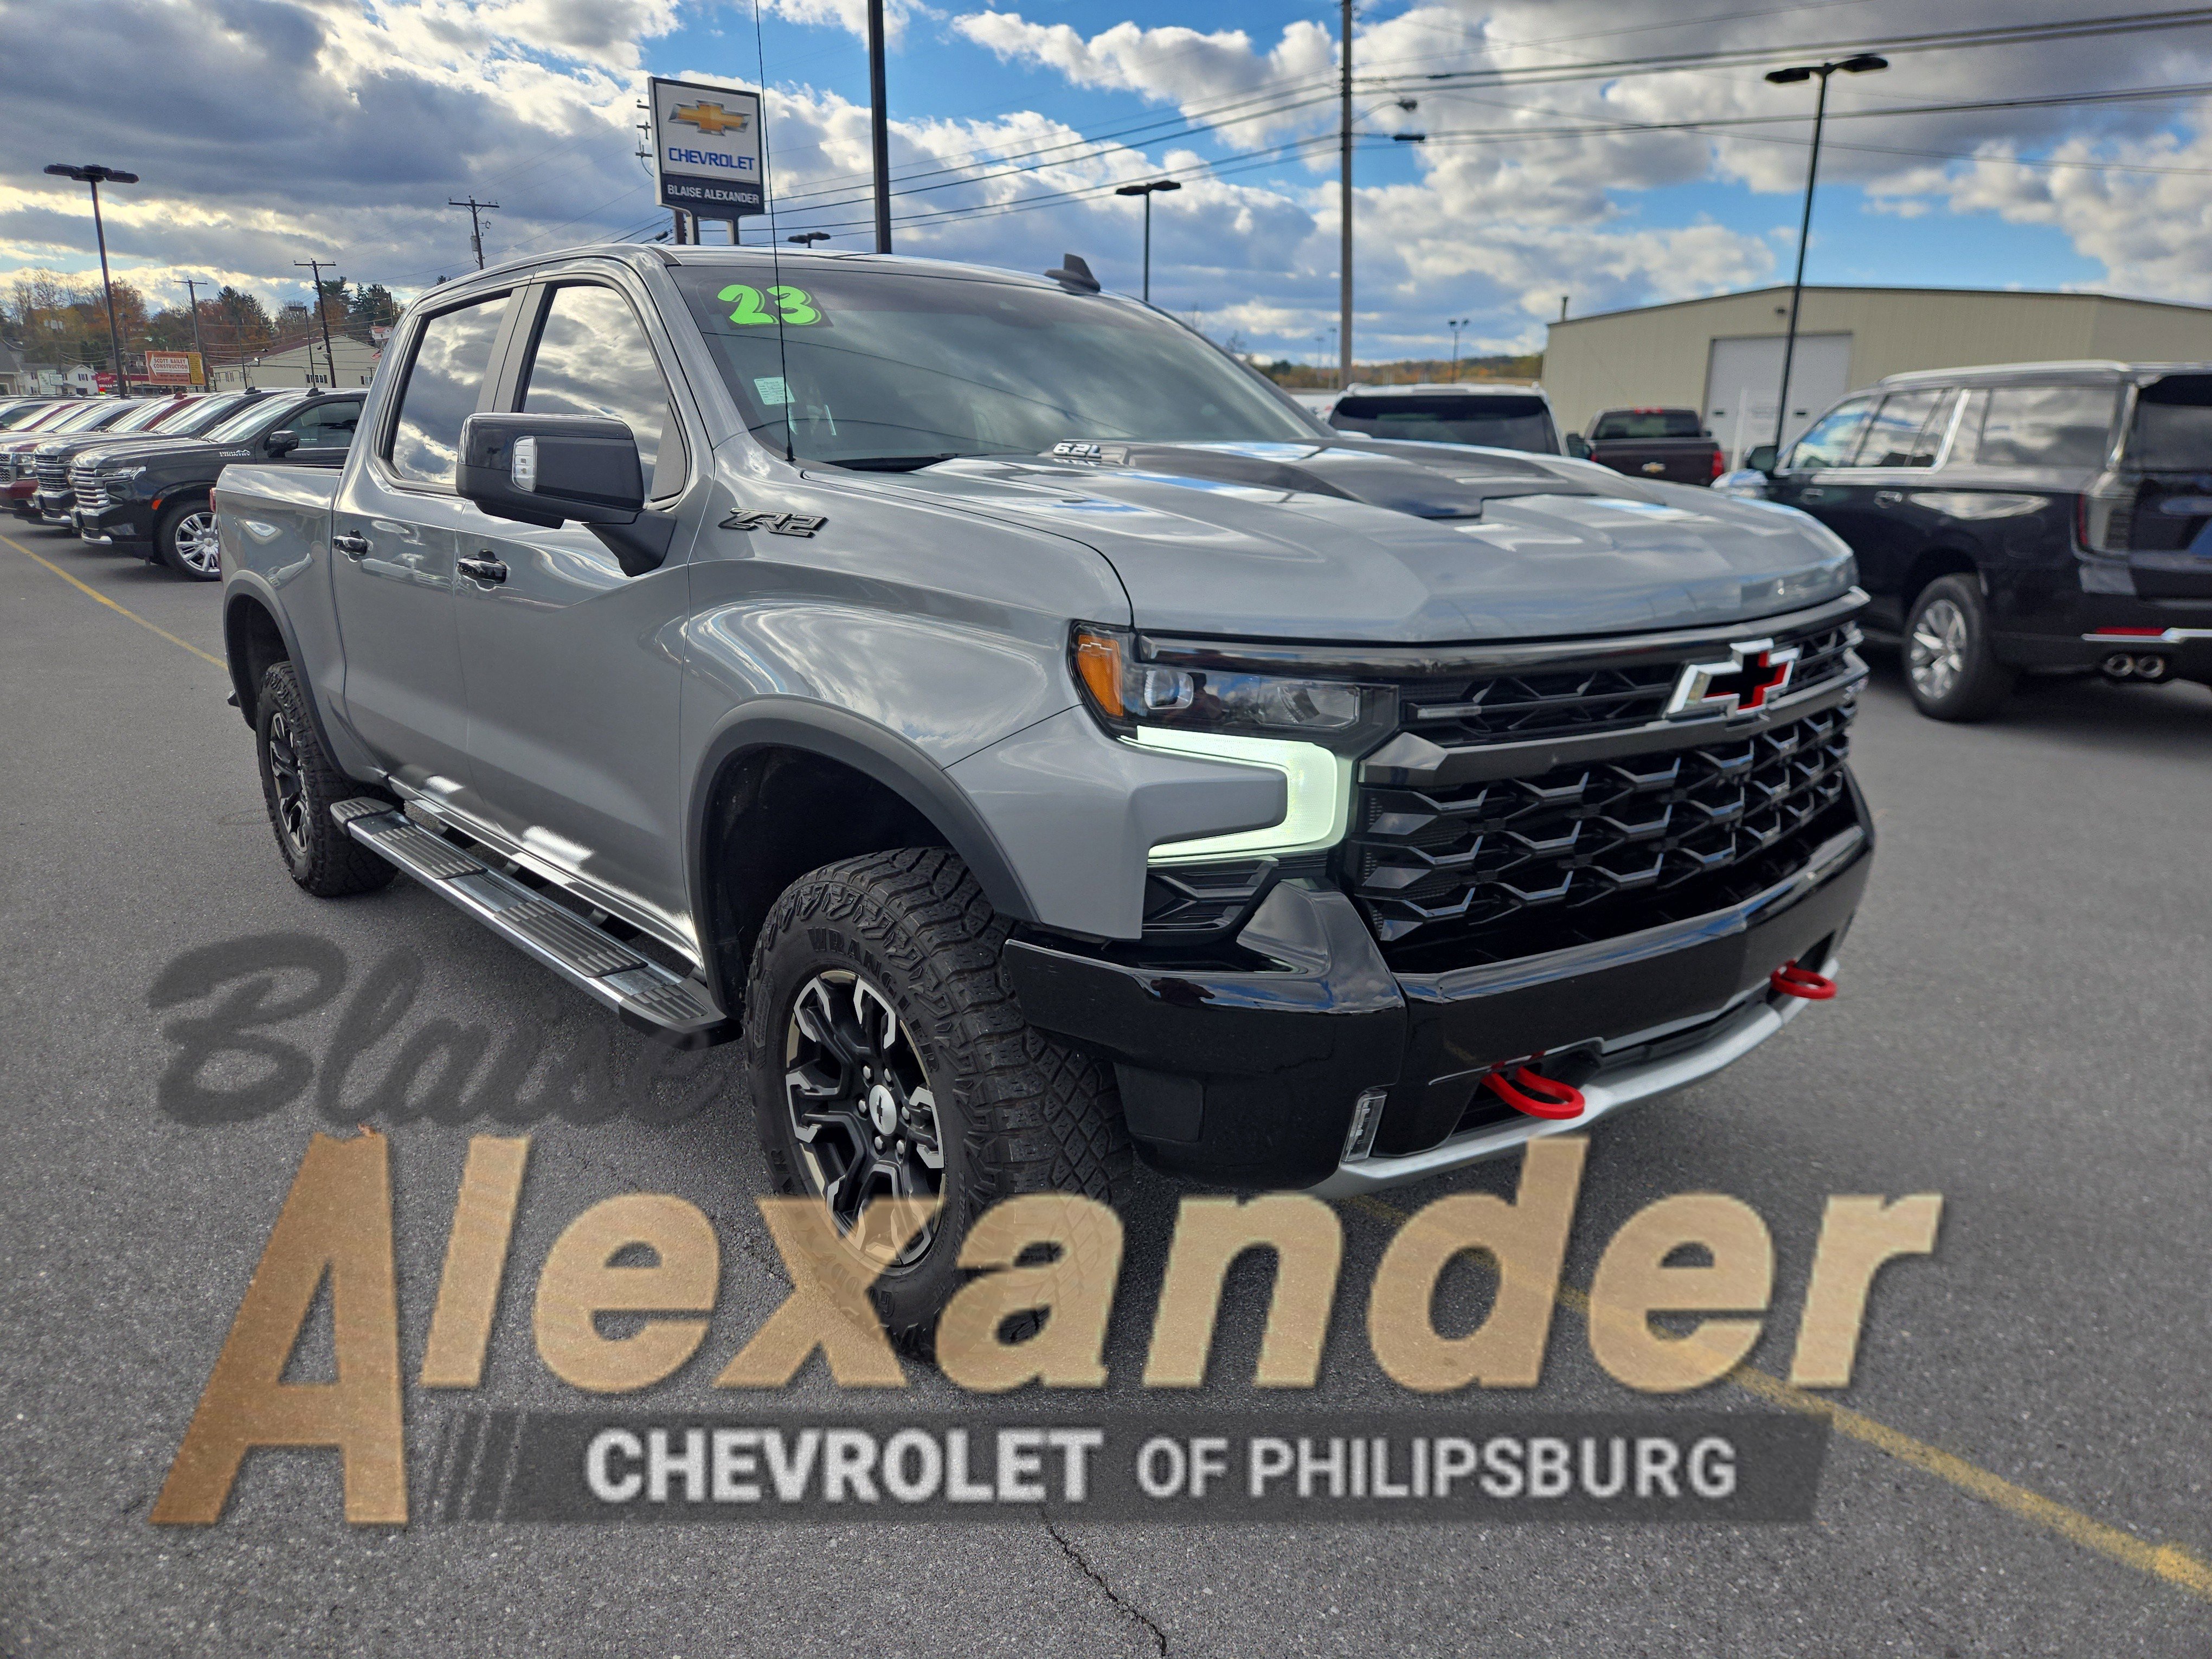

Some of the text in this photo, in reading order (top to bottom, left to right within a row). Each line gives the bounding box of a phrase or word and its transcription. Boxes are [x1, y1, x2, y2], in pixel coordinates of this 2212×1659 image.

[668, 147, 755, 170] CHEVROLET
[667, 184, 759, 204] BLAISE ALEXANDER
[717, 284, 821, 325] 23
[718, 507, 828, 538] ZR2
